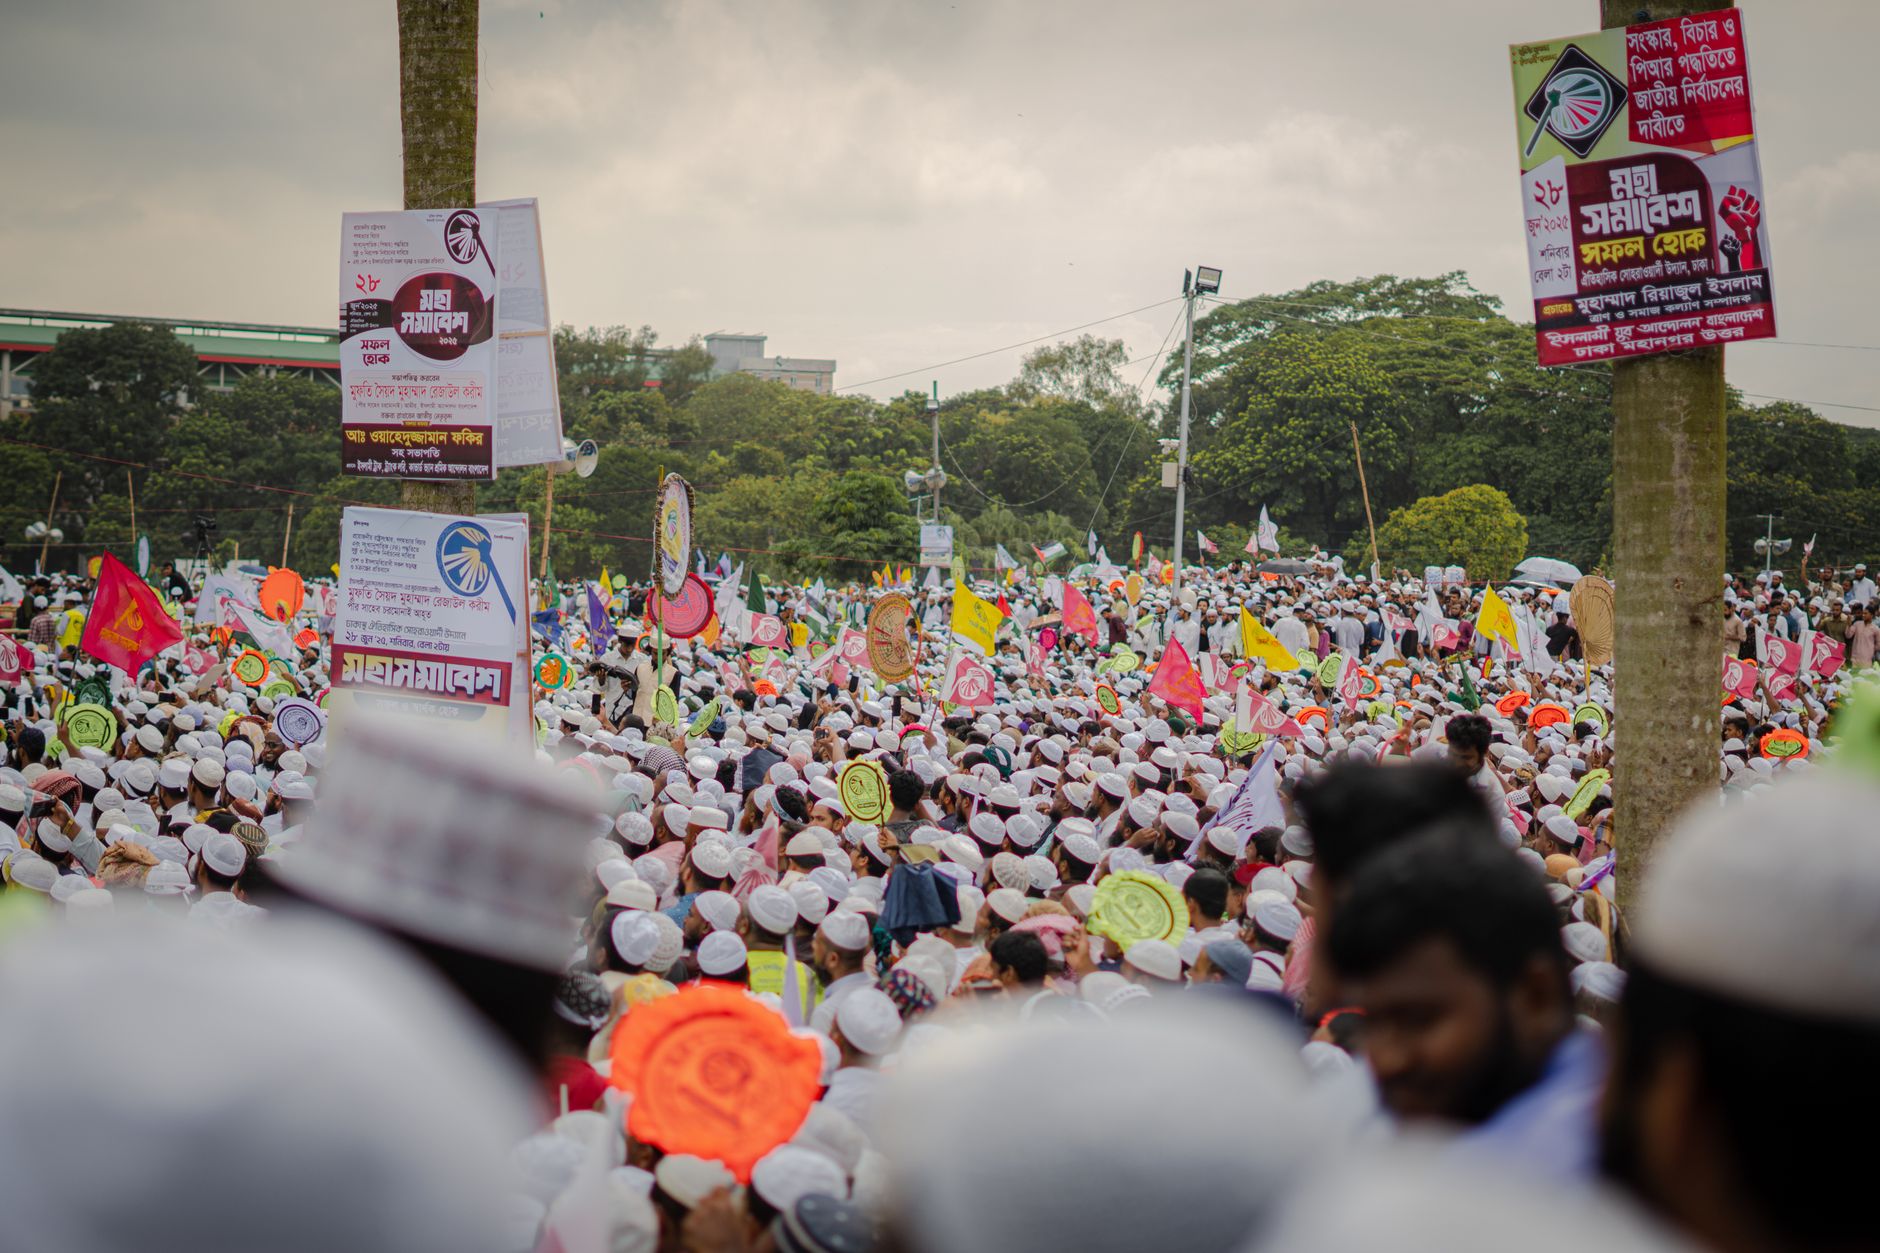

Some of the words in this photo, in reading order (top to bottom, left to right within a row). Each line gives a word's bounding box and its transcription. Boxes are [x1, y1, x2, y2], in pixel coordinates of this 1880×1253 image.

[1626, 27, 1678, 52] সংস্কার,
[1680, 17, 1718, 45] বিচার
[1722, 18, 1735, 36] ও
[1629, 55, 1674, 82] পিআর
[1677, 44, 1736, 74] পদ্ধতিতে
[1632, 80, 1678, 110] জাতীয়
[1680, 72, 1745, 105] নির্বাচনের
[1636, 110, 1685, 140] দাবীতে
[1609, 164, 1658, 200] মহা
[1534, 179, 1563, 210] ২৮
[1580, 190, 1702, 234] সমাবেশ
[1539, 243, 1569, 261] শনিবার
[1580, 236, 1645, 265] সফল
[1652, 228, 1706, 255] হোক
[355, 274, 380, 295] ২৮
[1535, 268, 1553, 283] বেলা
[1558, 264, 1572, 280] ২টা
[1581, 268, 1617, 286] ঐতিহাসিক
[420, 289, 451, 311] মহা
[1575, 290, 1636, 315] মুহাম্মাদ
[1641, 282, 1702, 304] রিয়াজুল
[1706, 274, 1762, 295] ইসলাম
[1615, 310, 1625, 319] ও
[1627, 306, 1661, 317] সমাজ
[1664, 299, 1700, 314] কল্যাণ
[1704, 293, 1752, 308] সম্পাদক
[400, 312, 468, 334] সমাবেশ
[1545, 325, 1611, 347] ইসলামী
[1614, 325, 1634, 343] যুব
[1636, 316, 1703, 335] আন্দোলন
[1706, 308, 1764, 327] বাংলাদেশ
[360, 339, 390, 351] সফল
[439, 336, 458, 346] ২০২৫
[1573, 342, 1616, 358] ঢাকা
[1622, 333, 1695, 351] মহানগর
[1700, 326, 1745, 340] উত্তর
[362, 354, 390, 366] হোক
[349, 380, 373, 401] মুফতি
[374, 382, 395, 399] সৈয়দ
[429, 383, 460, 400] রেজাউল
[462, 380, 484, 400] করীম
[345, 429, 366, 444] আঃ
[369, 429, 449, 447] ওয়াহেদুজ্জামান
[450, 427, 484, 446] ফকির
[391, 448, 406, 458] সহ
[407, 447, 441, 458] সভাপতি
[347, 585, 372, 601] মুফতি
[375, 588, 397, 602] সৈয়দ
[400, 593, 431, 606] মুহাম্মাদ
[433, 596, 465, 610] রেজাউল
[468, 597, 491, 613] করীম
[347, 600, 359, 612] পীর
[361, 603, 380, 613] সাহেব
[382, 605, 412, 617] চরমোনাই
[368, 620, 403, 634] ঐতিহাসিক
[345, 631, 358, 642] ২৮
[360, 634, 374, 645] জুন
[417, 639, 433, 650] বেলা
[342, 652, 502, 698] মহাসমাবেশ
